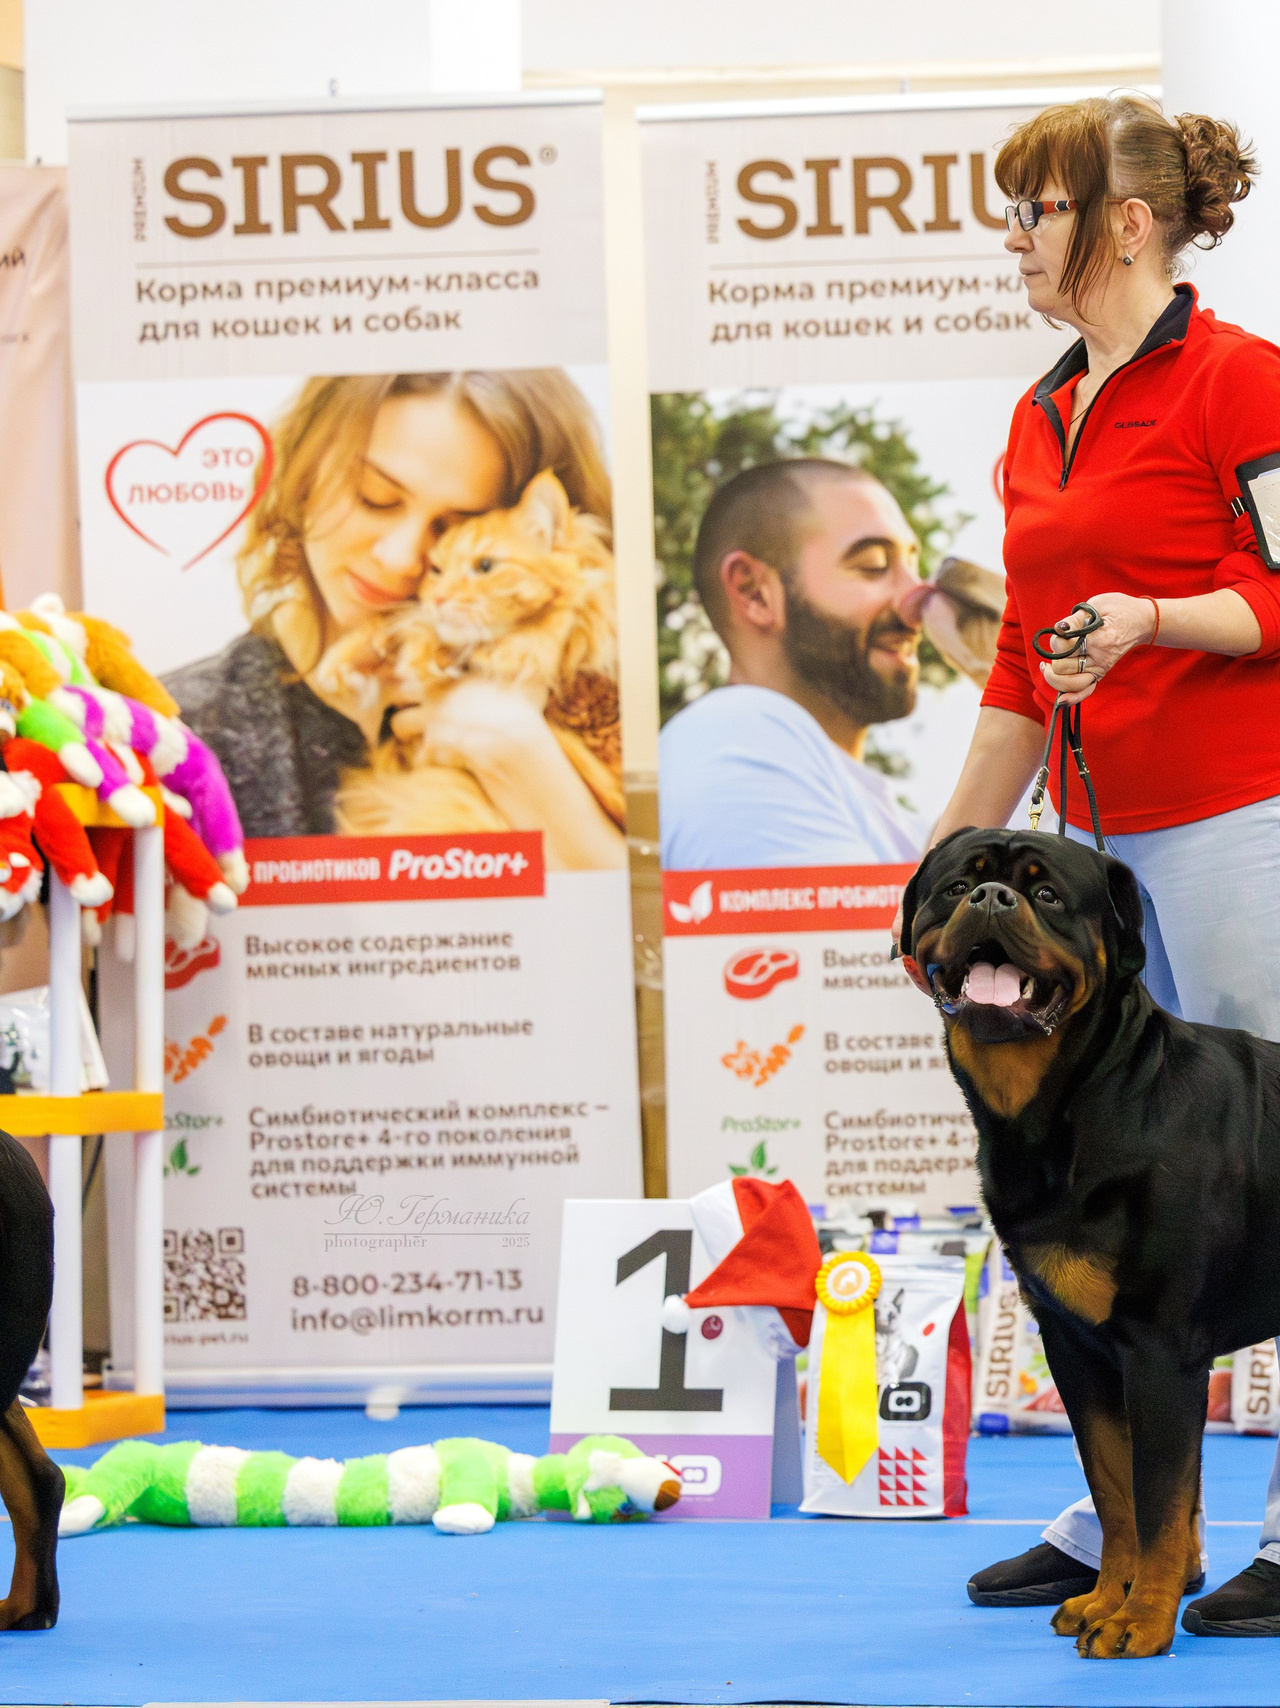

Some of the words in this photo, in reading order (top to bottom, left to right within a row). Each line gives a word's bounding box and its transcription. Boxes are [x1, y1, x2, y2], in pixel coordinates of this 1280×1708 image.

[163, 145, 536, 239] SIRIUS
[736, 152, 1006, 241] SIRIU
[136, 278, 244, 309] Корма
[256, 269, 540, 300] премиум-класса
[709, 279, 814, 307] Корма
[139, 318, 200, 344] для
[213, 314, 321, 338] кошек
[334, 315, 352, 333] и
[365, 307, 462, 333] собак
[711, 321, 771, 344] для
[784, 314, 892, 338] кошек
[905, 315, 923, 332] и
[935, 307, 1032, 332] собак
[202, 449, 254, 469] ЭТО
[128, 481, 244, 505] ЛЮБОВЬ
[254, 858, 380, 883] ПРОБИОТИКОВ
[388, 848, 528, 881] ProStor+
[246, 935, 354, 957] Высокое
[360, 932, 513, 954] содержание
[247, 961, 341, 980] мясных
[348, 955, 521, 978] ингредиентов
[248, 1024, 263, 1043] В
[271, 1026, 363, 1043] составе
[371, 1020, 533, 1042] натуральные
[825, 1032, 839, 1051] В
[845, 1035, 934, 1050] составе
[249, 1051, 330, 1070] овощи
[338, 1051, 351, 1064] и
[359, 1047, 434, 1067] ягоды
[825, 1058, 902, 1075] овощи
[909, 1058, 921, 1070] и
[249, 1103, 460, 1128] Симбиотический
[469, 1101, 587, 1121] комплекс
[825, 1109, 969, 1130] Симбиотиче
[250, 1131, 367, 1152] Prostore+
[377, 1128, 430, 1146] 4-го
[439, 1126, 571, 1145] поколения
[251, 1159, 295, 1178] для
[302, 1153, 444, 1176] поддержки
[451, 1146, 579, 1169] иммунной
[826, 1159, 868, 1177] для
[253, 1178, 357, 1199] системы
[826, 1181, 926, 1197] системы
[293, 1269, 522, 1297] 8-800-234-71-13
[291, 1305, 543, 1335] info@limkorm.ru
[609, 1229, 723, 1411] 1
